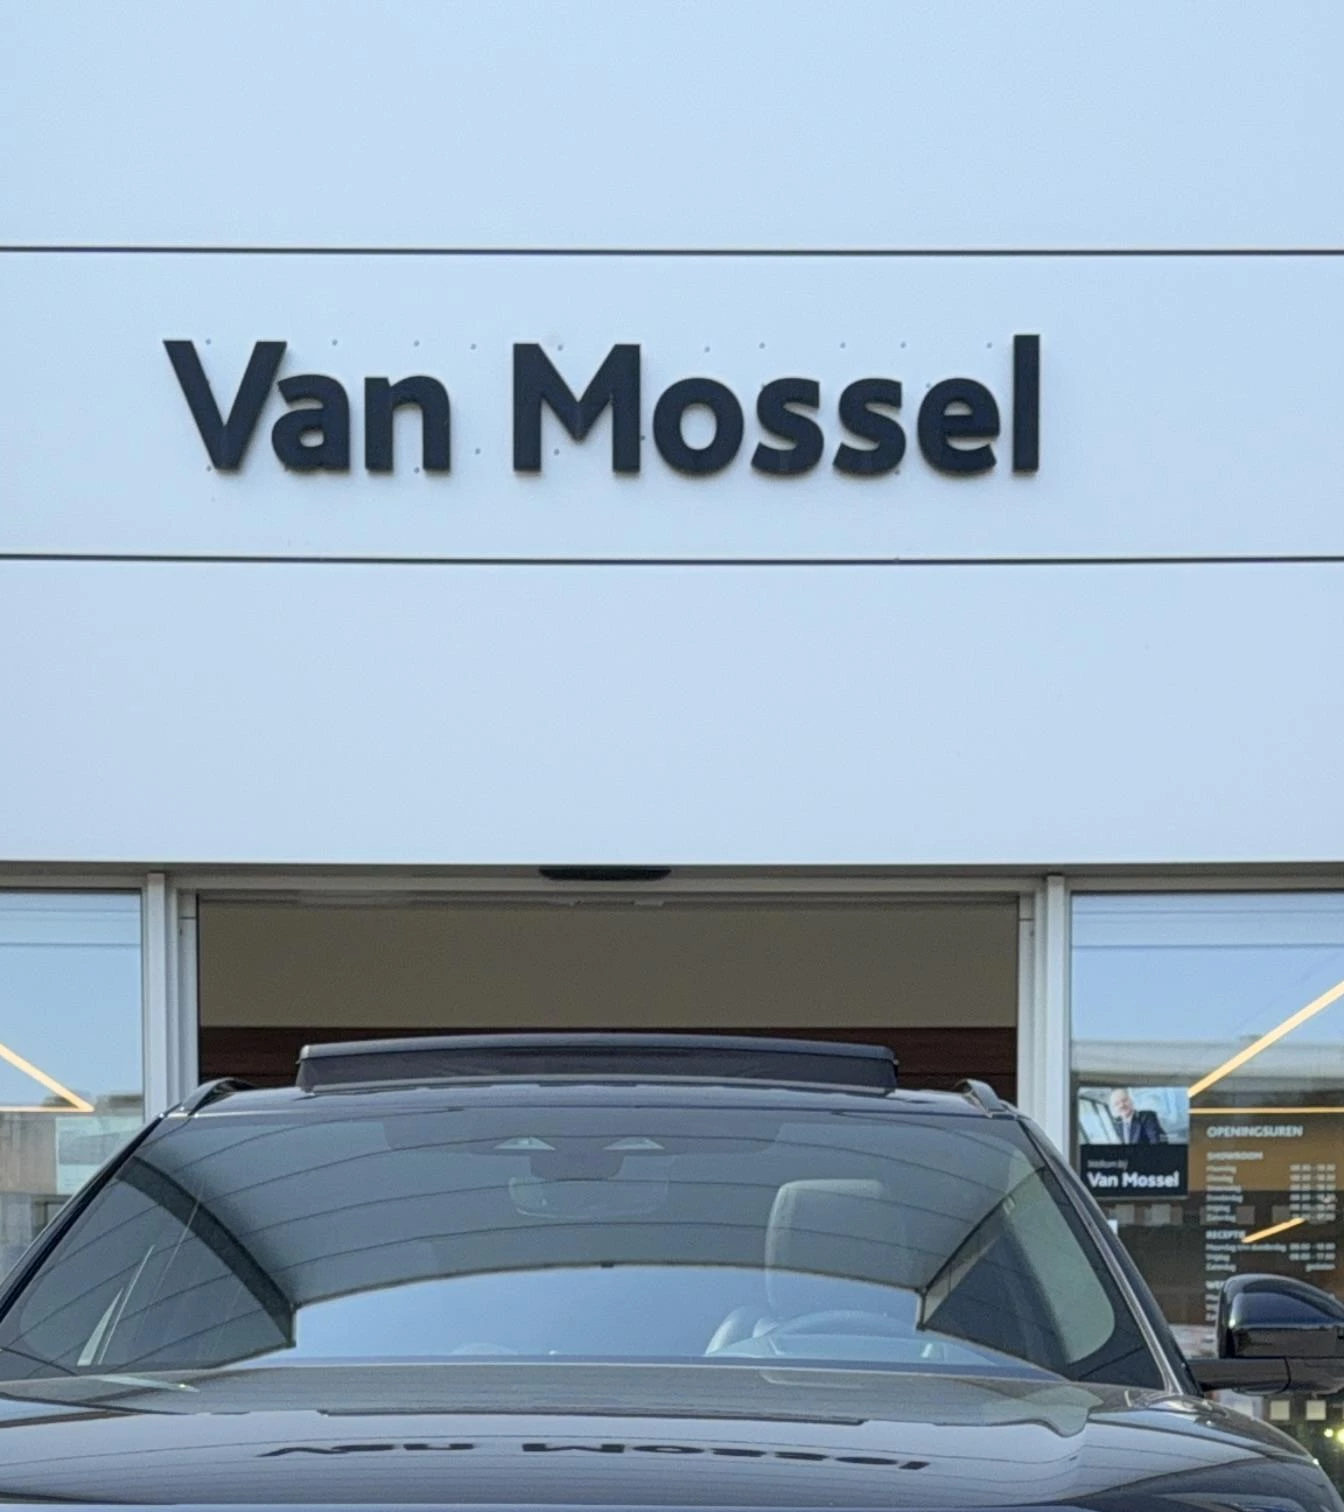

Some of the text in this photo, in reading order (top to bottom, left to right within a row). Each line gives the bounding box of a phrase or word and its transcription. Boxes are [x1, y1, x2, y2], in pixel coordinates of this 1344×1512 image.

[163, 333, 1041, 474] Van Mossel
[1206, 1125, 1304, 1139] OPENINGSUREN
[1087, 1170, 1180, 1187] Van Mossel
